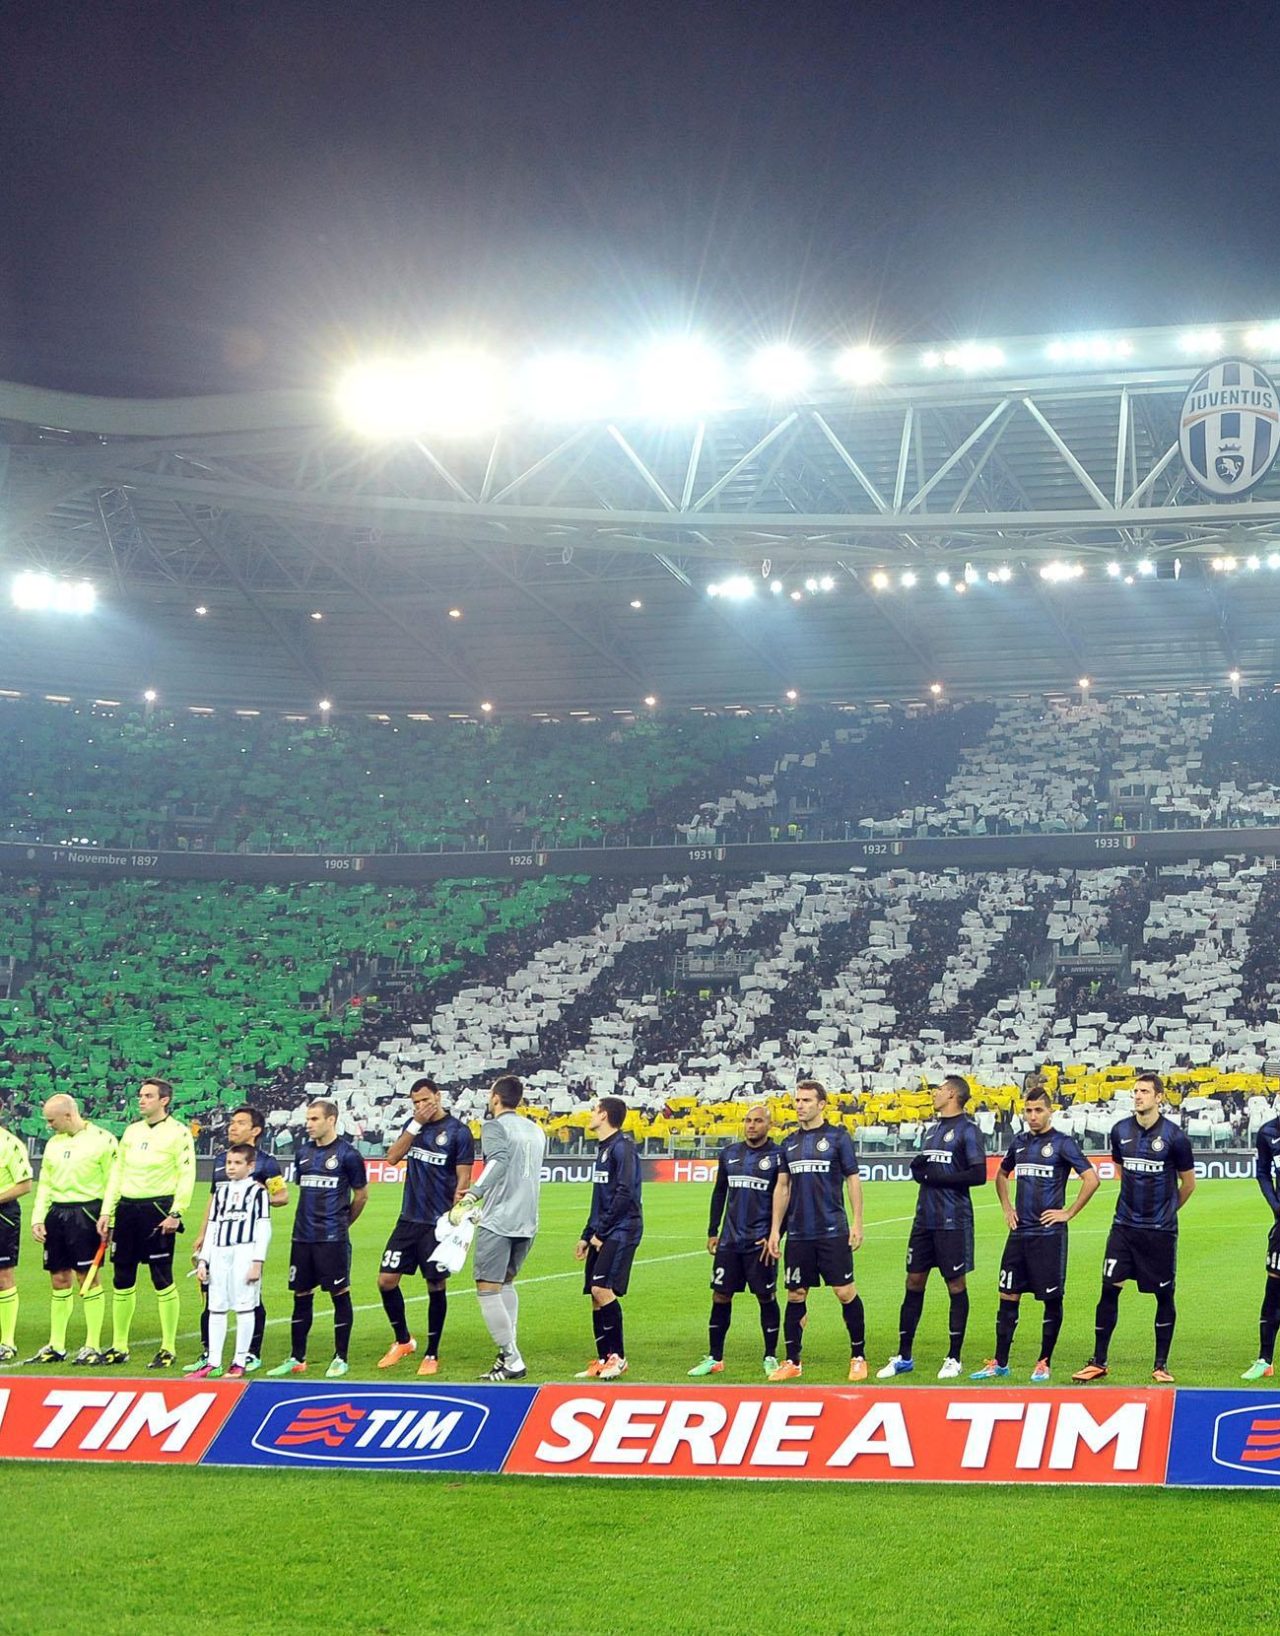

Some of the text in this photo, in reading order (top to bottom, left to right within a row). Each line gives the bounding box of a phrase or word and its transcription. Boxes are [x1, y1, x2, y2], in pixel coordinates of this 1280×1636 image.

[1189, 389, 1273, 413] JUVENTUS
[862, 844, 887, 855] 1932
[1094, 838, 1120, 848] 1933
[68, 852, 127, 865] Novembre
[131, 855, 158, 866] 1897
[508, 856, 532, 866] 1926
[688, 850, 713, 861] 1931
[324, 860, 350, 869] 1905
[382, 1250, 402, 1268] 35
[1103, 1258, 1118, 1277] 17
[786, 1267, 801, 1284] 14
[999, 1270, 1014, 1290] 21
[33, 1389, 218, 1452] TIM
[354, 1408, 465, 1450] TIM
[534, 1396, 1148, 1471] SERIE A TIM
